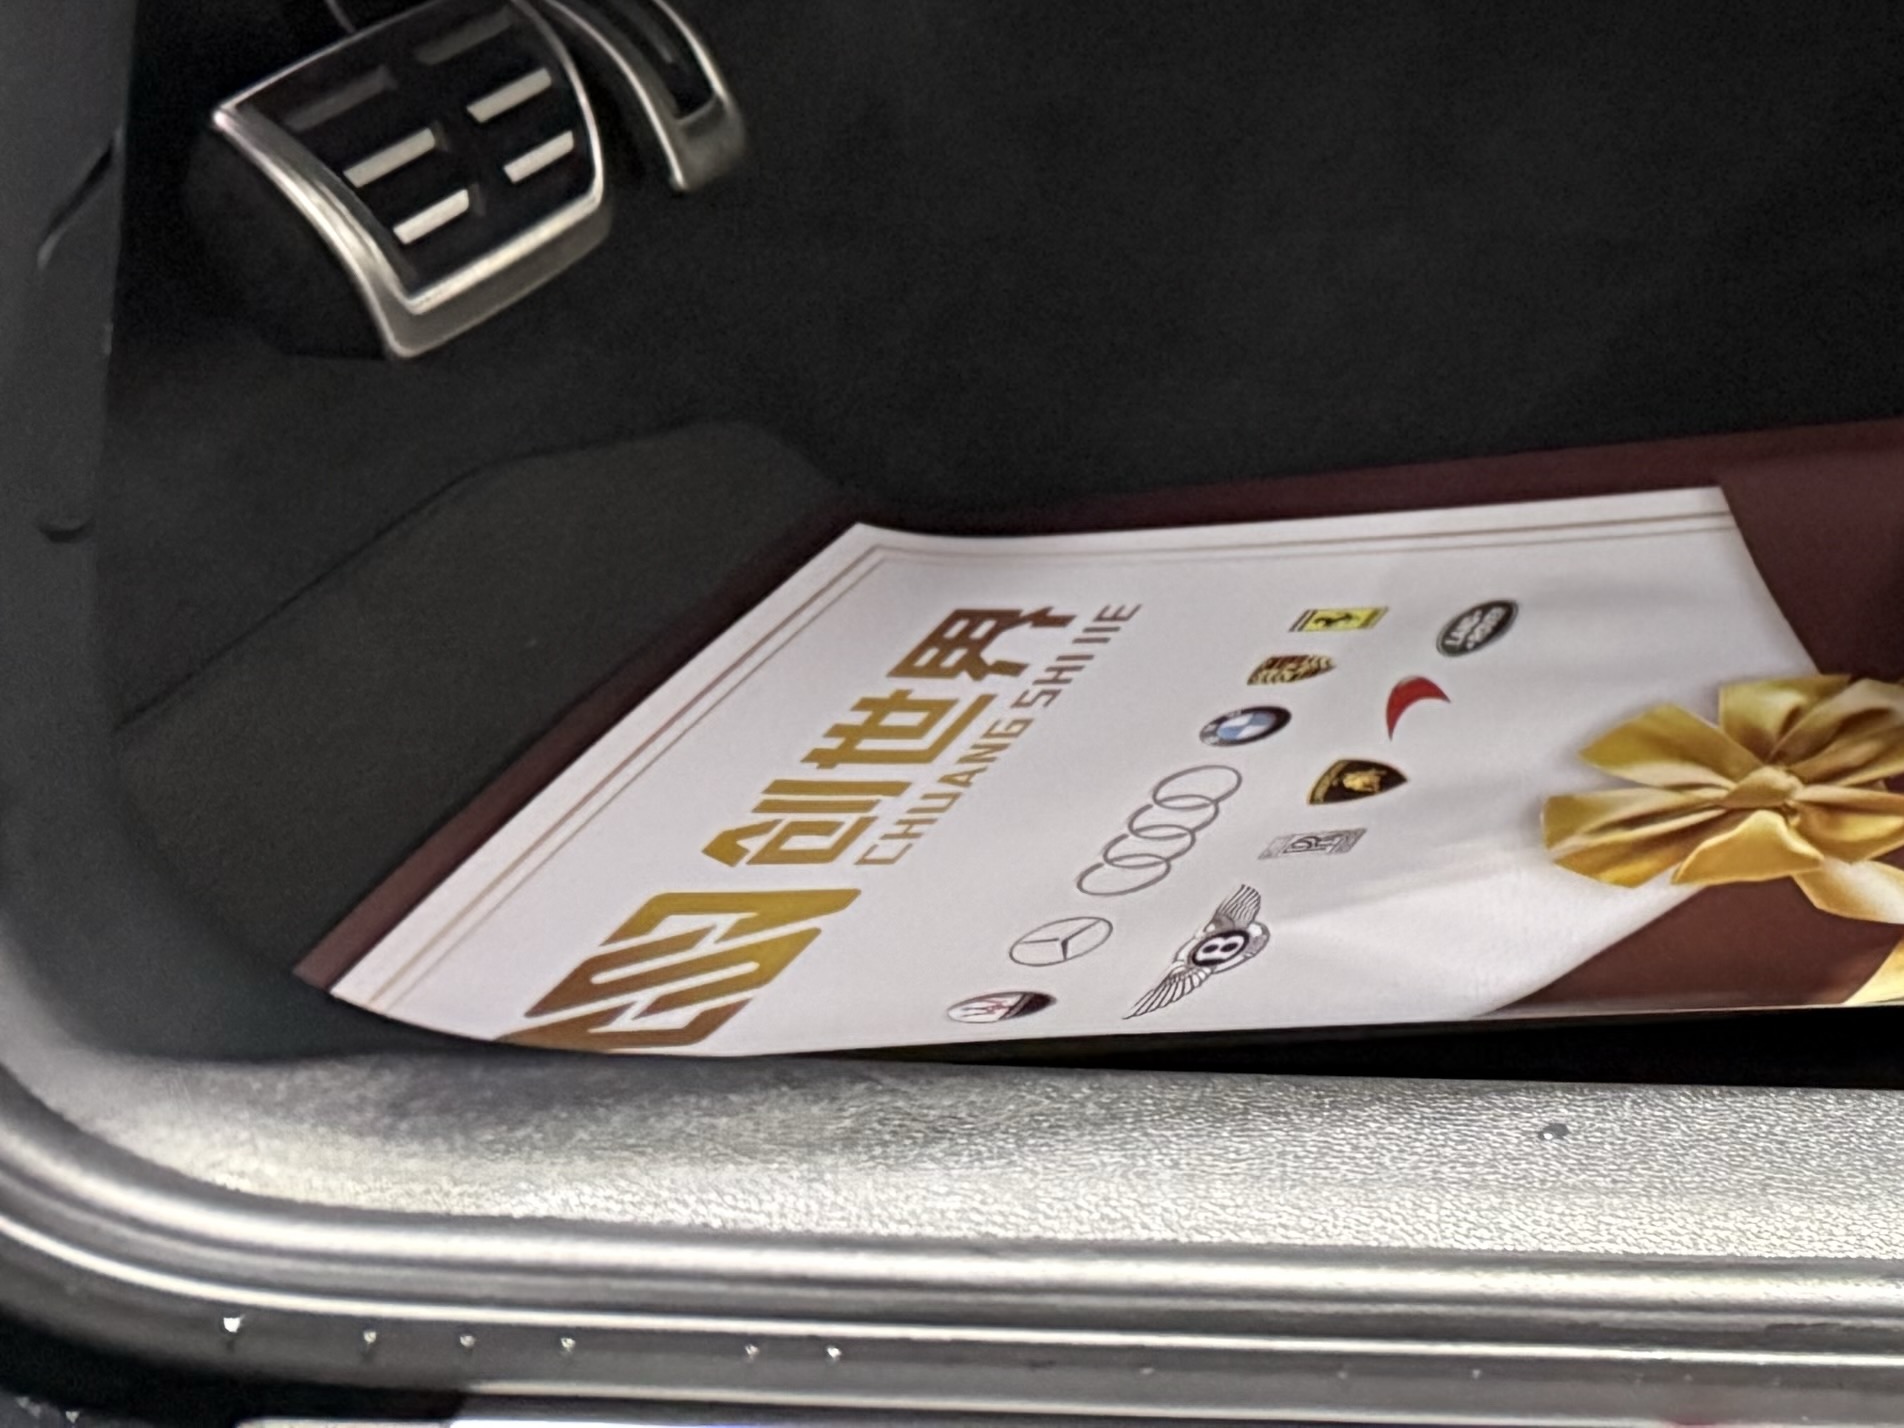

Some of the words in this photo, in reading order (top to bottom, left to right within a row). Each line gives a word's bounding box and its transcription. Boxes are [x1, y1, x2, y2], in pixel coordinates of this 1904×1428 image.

[702, 606, 1077, 868] 创世界
[853, 717, 1034, 866] CHUANG
[1010, 654, 1095, 709] SHI
